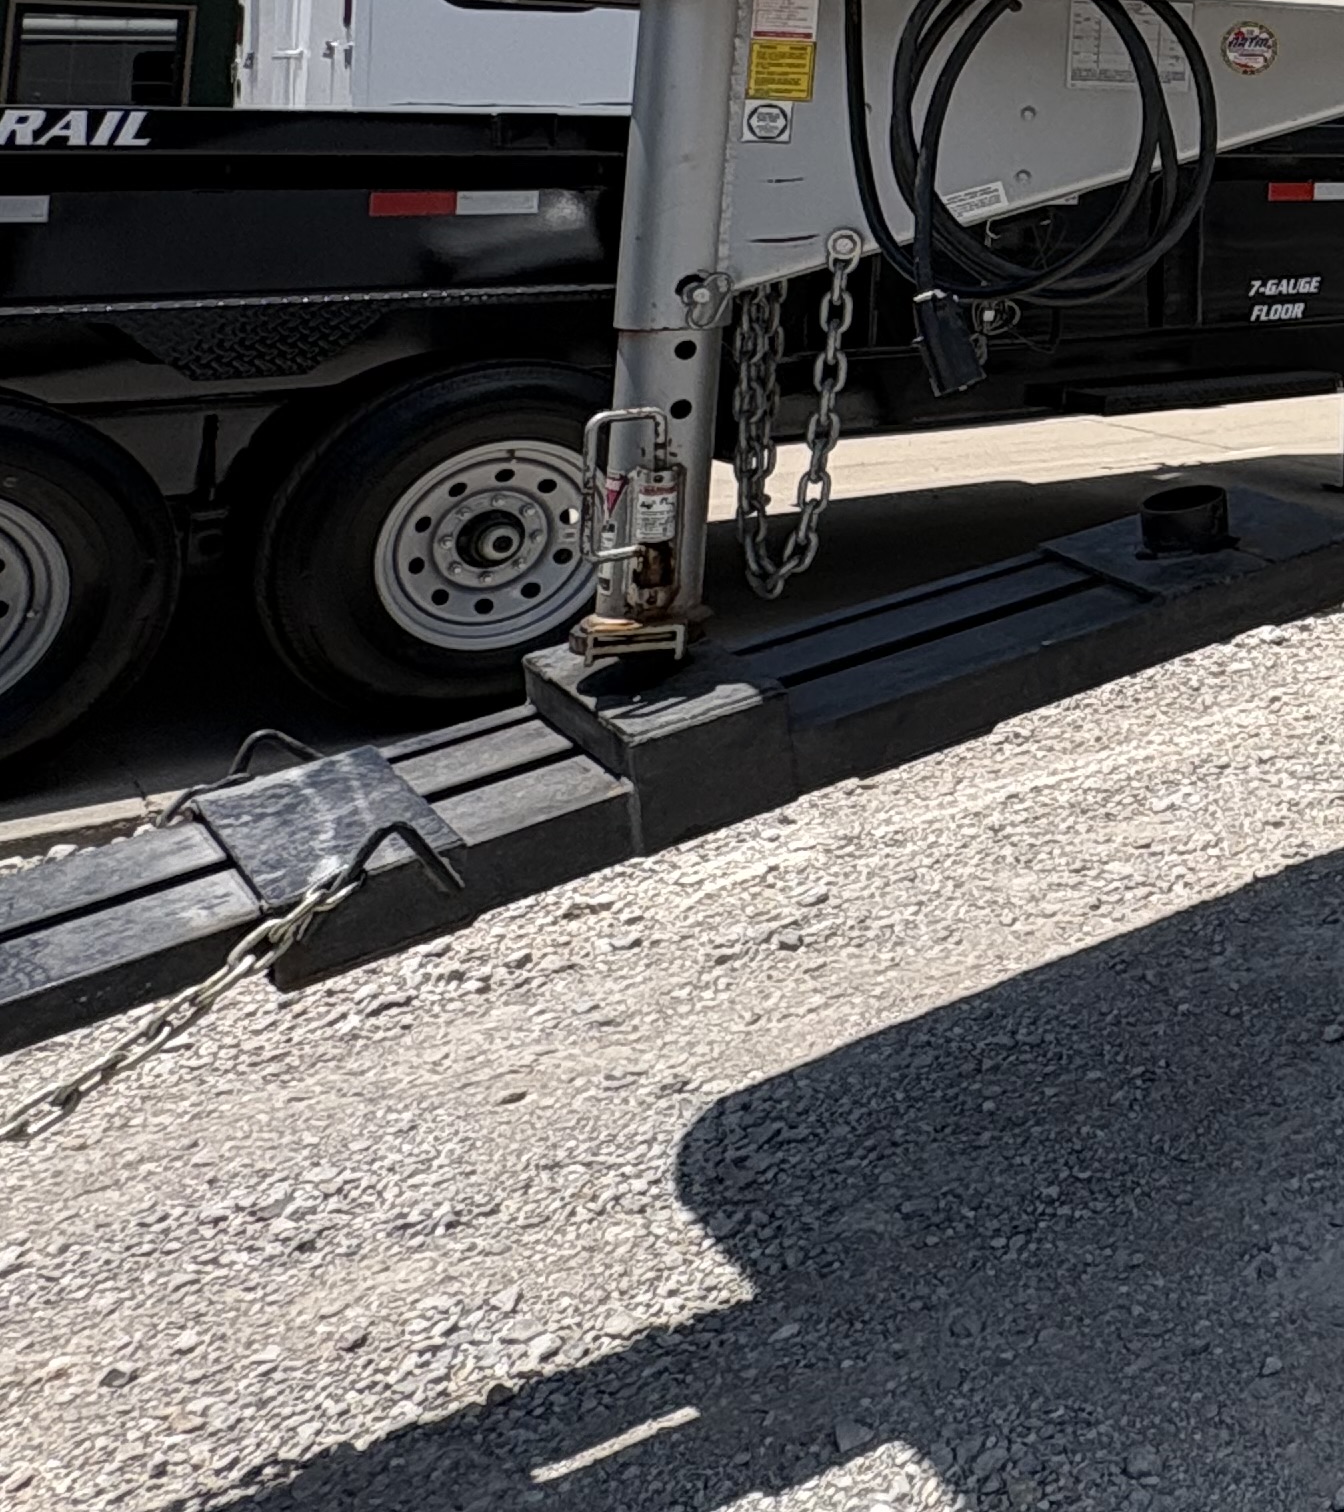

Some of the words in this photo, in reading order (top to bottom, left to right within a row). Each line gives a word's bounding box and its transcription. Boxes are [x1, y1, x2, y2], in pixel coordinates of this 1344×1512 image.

[0, 109, 152, 146] RAIL
[1248, 276, 1322, 297] 7-GAUGE
[1250, 303, 1306, 322] FLOOR
